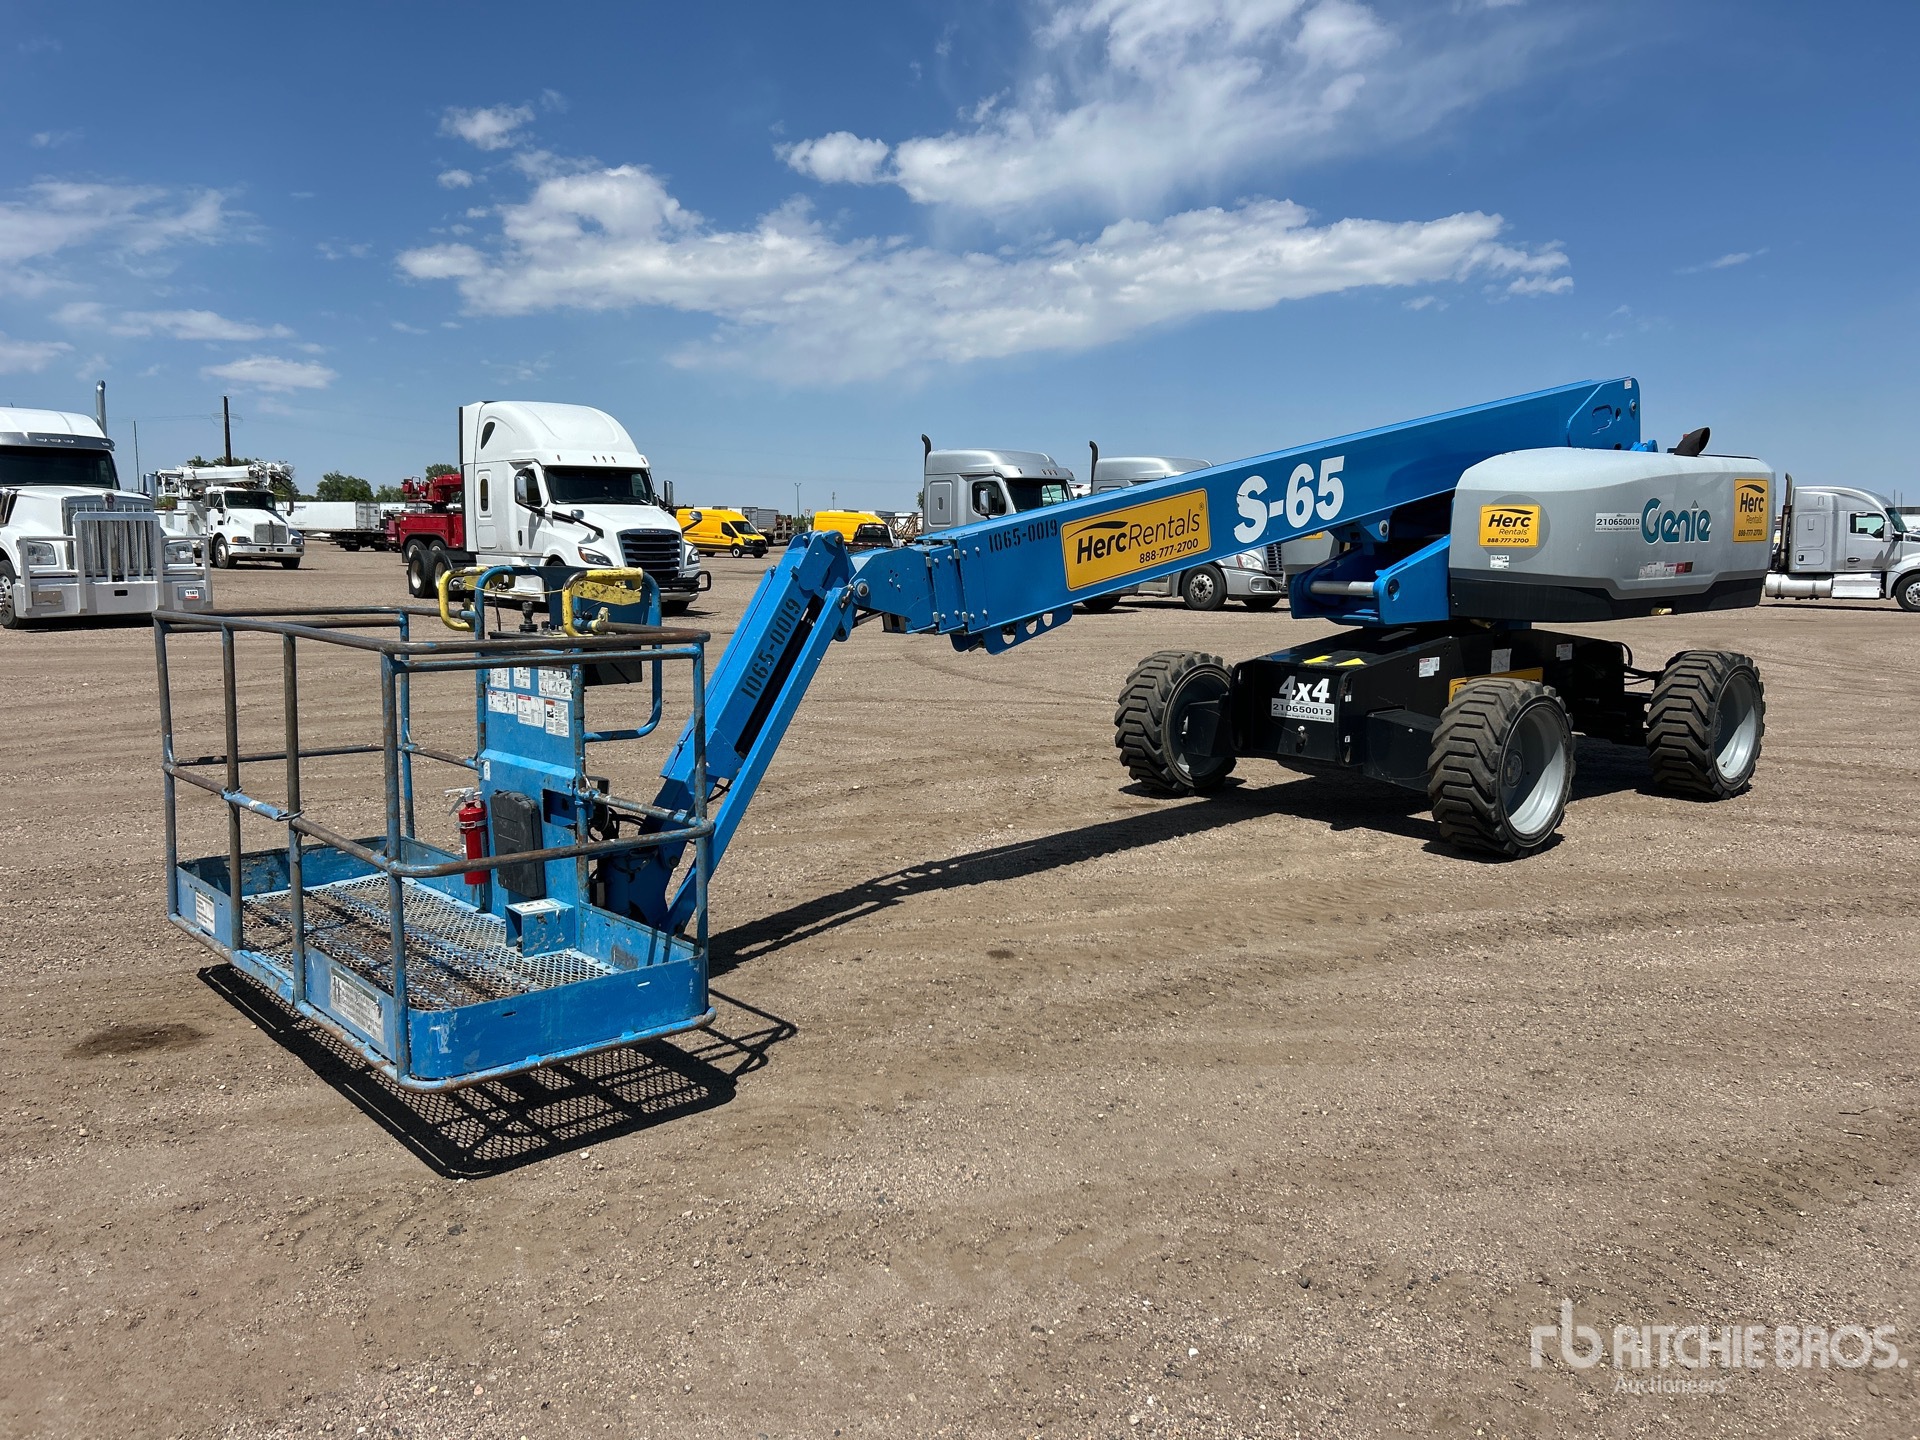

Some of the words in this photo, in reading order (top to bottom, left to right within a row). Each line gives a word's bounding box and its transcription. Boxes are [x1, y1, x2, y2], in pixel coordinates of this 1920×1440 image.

[1234, 455, 1345, 543] S-65
[1739, 492, 1765, 513] Herc
[1488, 513, 1532, 528] Herc
[1498, 528, 1528, 536] Rentals
[1596, 518, 1640, 526] 210650019
[1641, 498, 1712, 545] Genie
[988, 519, 1058, 553] 1065-0019
[1139, 538, 1199, 564] 888-777-2700
[741, 598, 801, 700] 1065-0019
[1279, 675, 1330, 703] 4x4
[1272, 703, 1332, 716] 210650019
